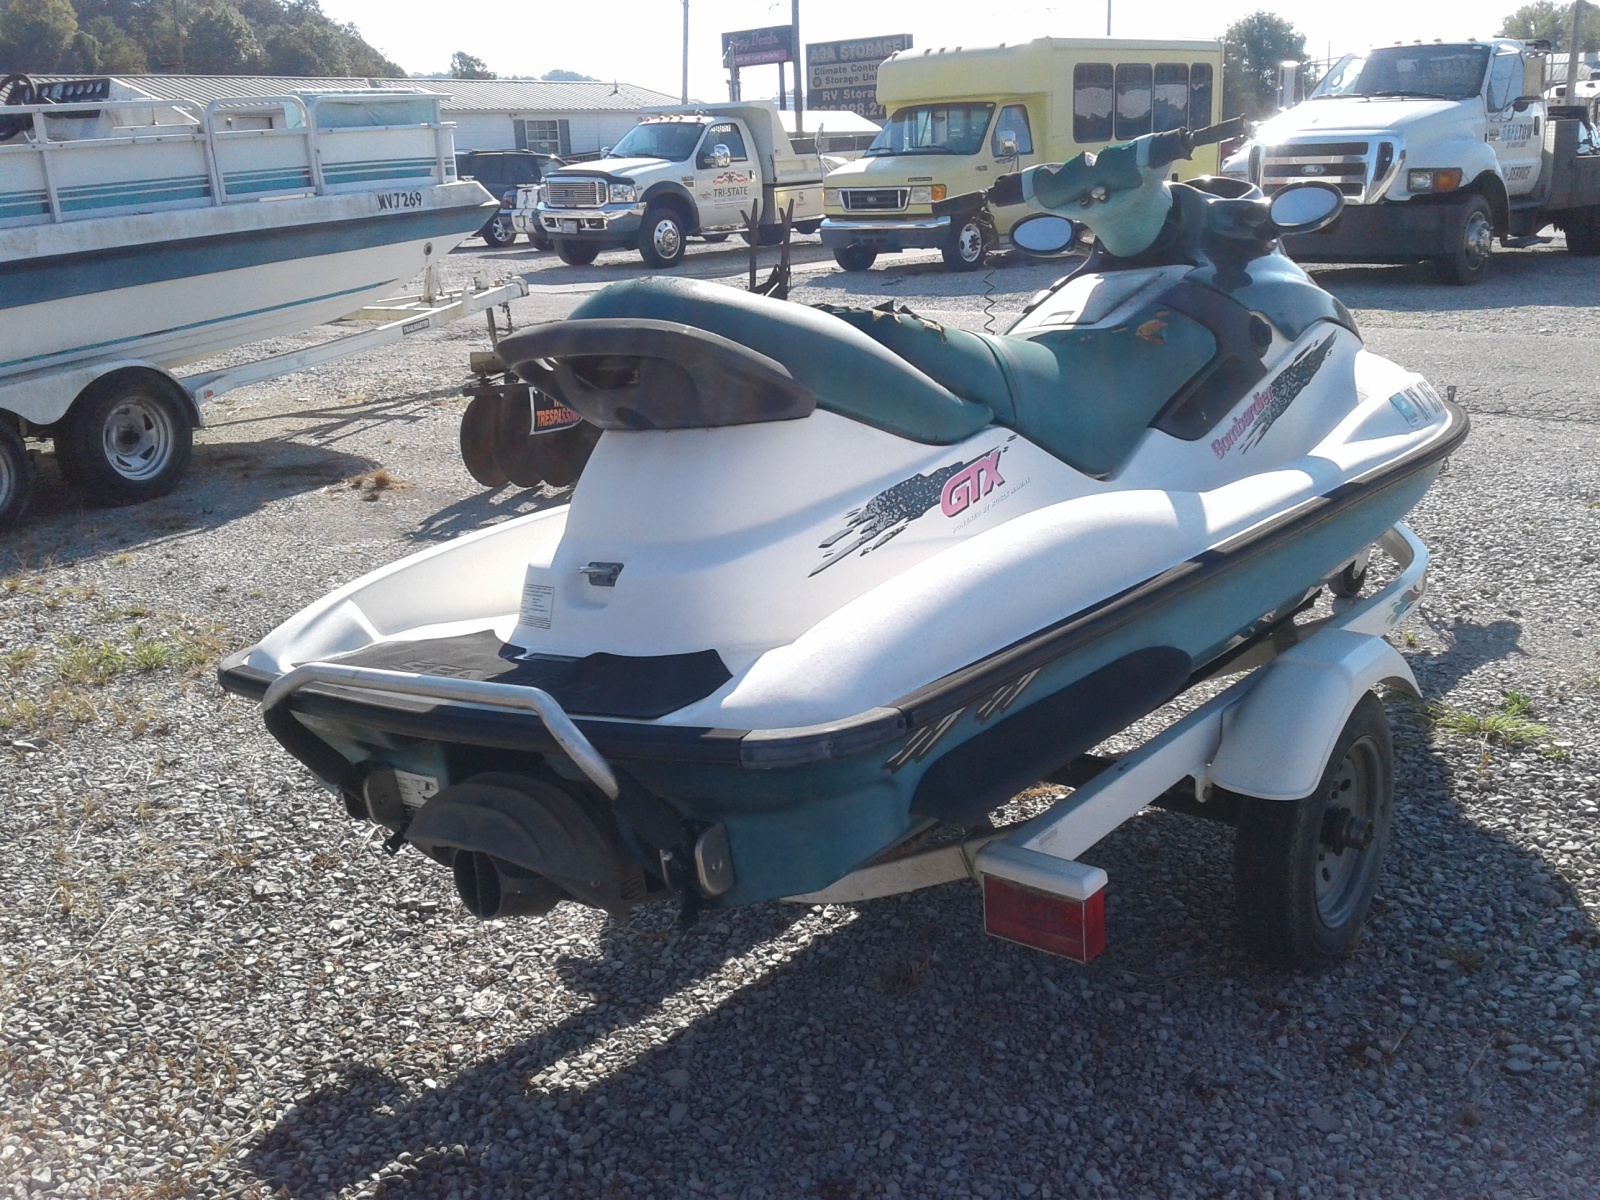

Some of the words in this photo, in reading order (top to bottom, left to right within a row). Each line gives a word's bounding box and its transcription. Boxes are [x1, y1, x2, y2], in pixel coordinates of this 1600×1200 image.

[841, 38, 902, 60] STORAGE
[814, 65, 847, 76] Climate
[825, 75, 859, 85] Storage
[822, 90, 838, 100] RV
[713, 186, 748, 198] TRI-STATE
[1211, 385, 1274, 460] Bombardier
[941, 450, 1005, 517] GTX
